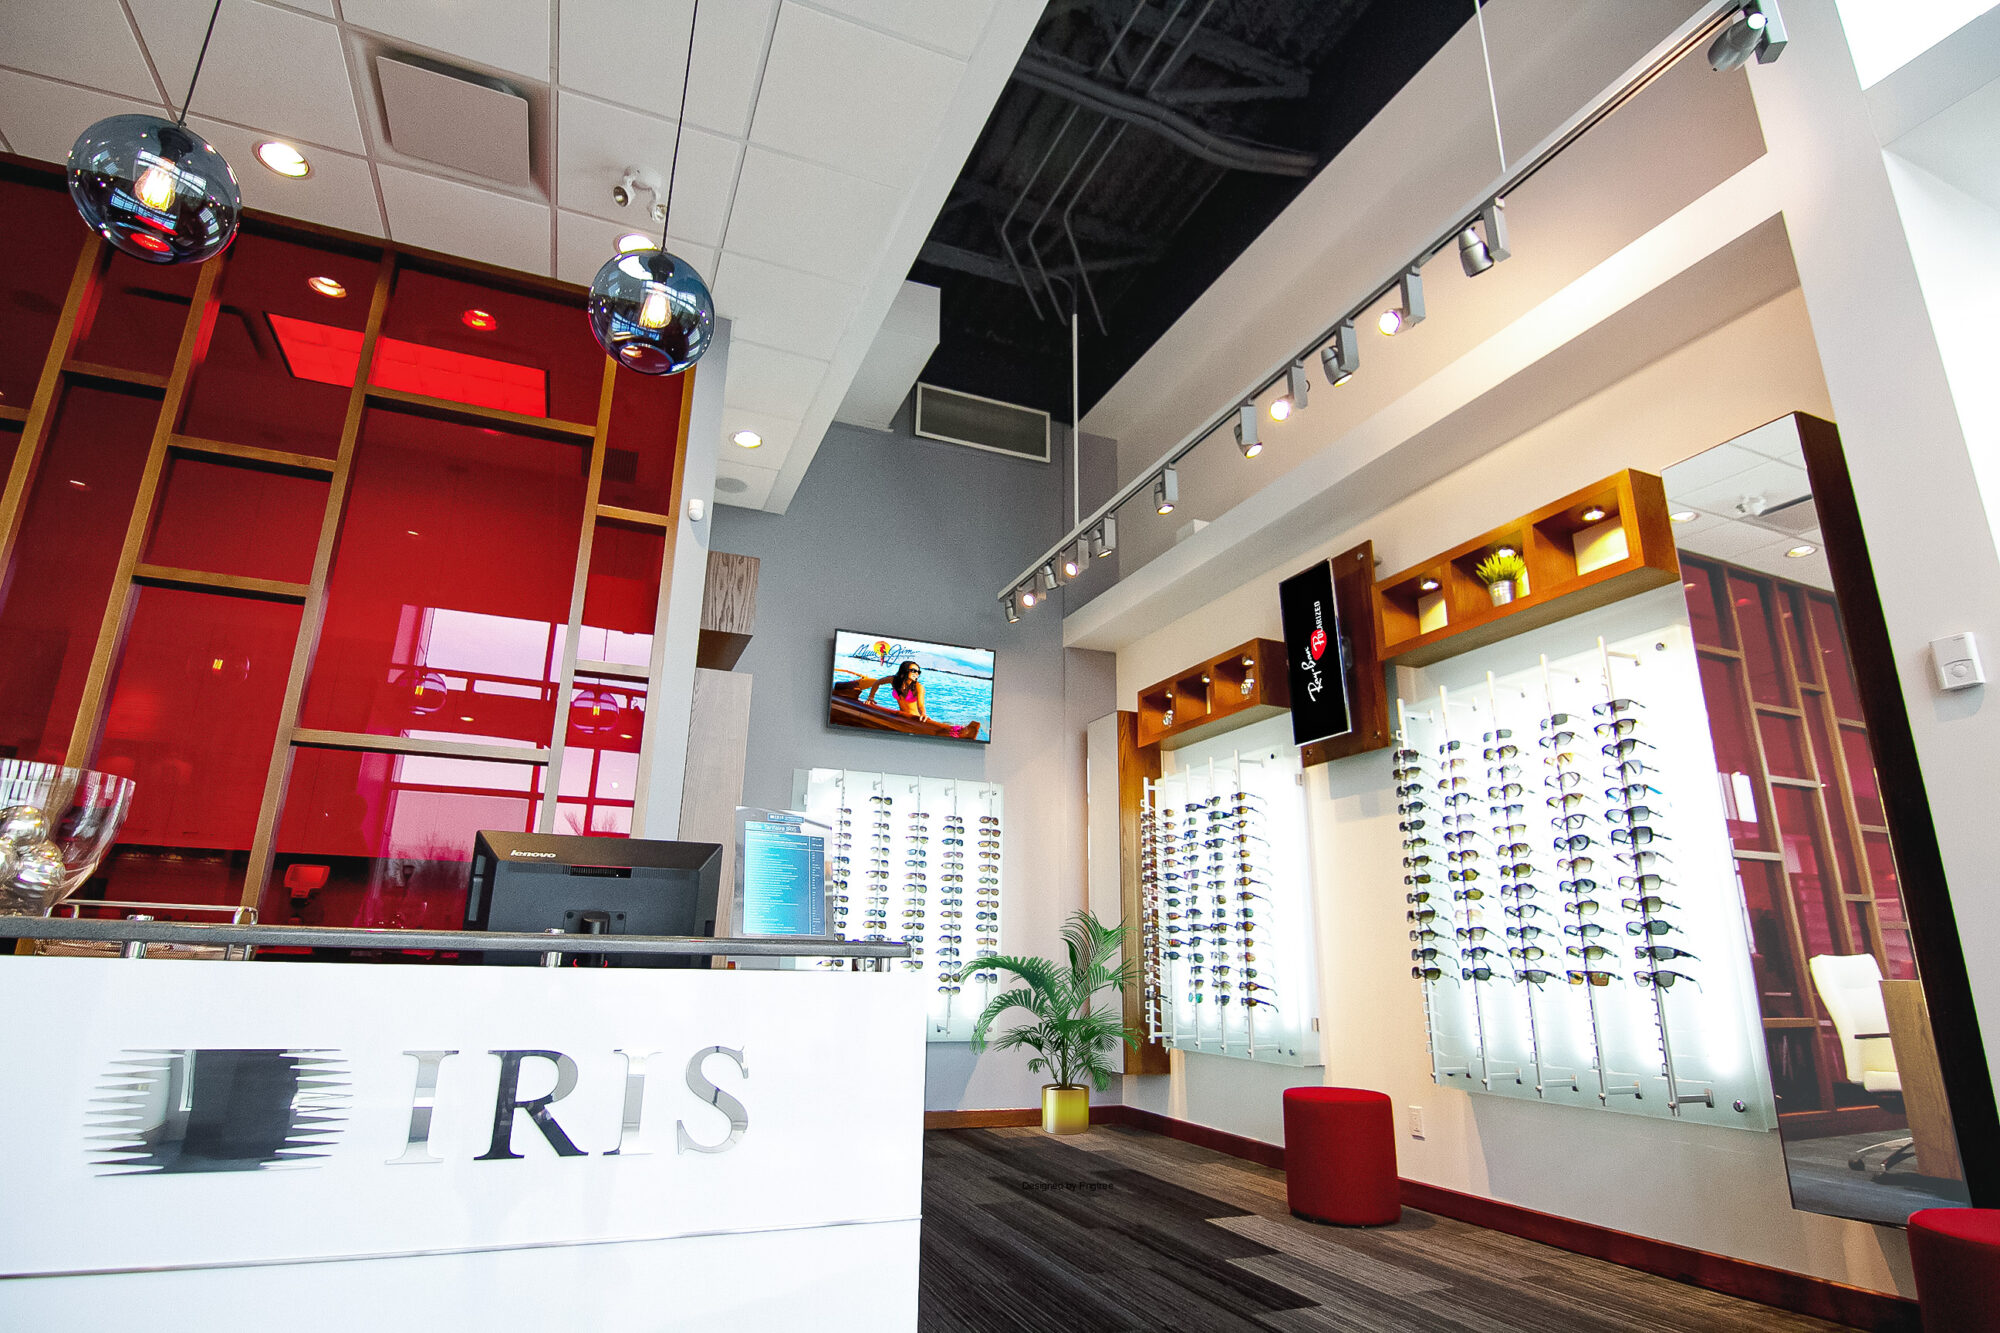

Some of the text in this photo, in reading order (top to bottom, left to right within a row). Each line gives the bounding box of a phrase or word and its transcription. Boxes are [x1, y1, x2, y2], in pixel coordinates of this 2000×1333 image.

[1312, 600, 1324, 652] POLARIZED
[886, 643, 918, 668] Jim
[1301, 646, 1323, 702] Ray-Ban
[510, 849, 557, 858] lenovo
[384, 1045, 750, 1165] IRIS
